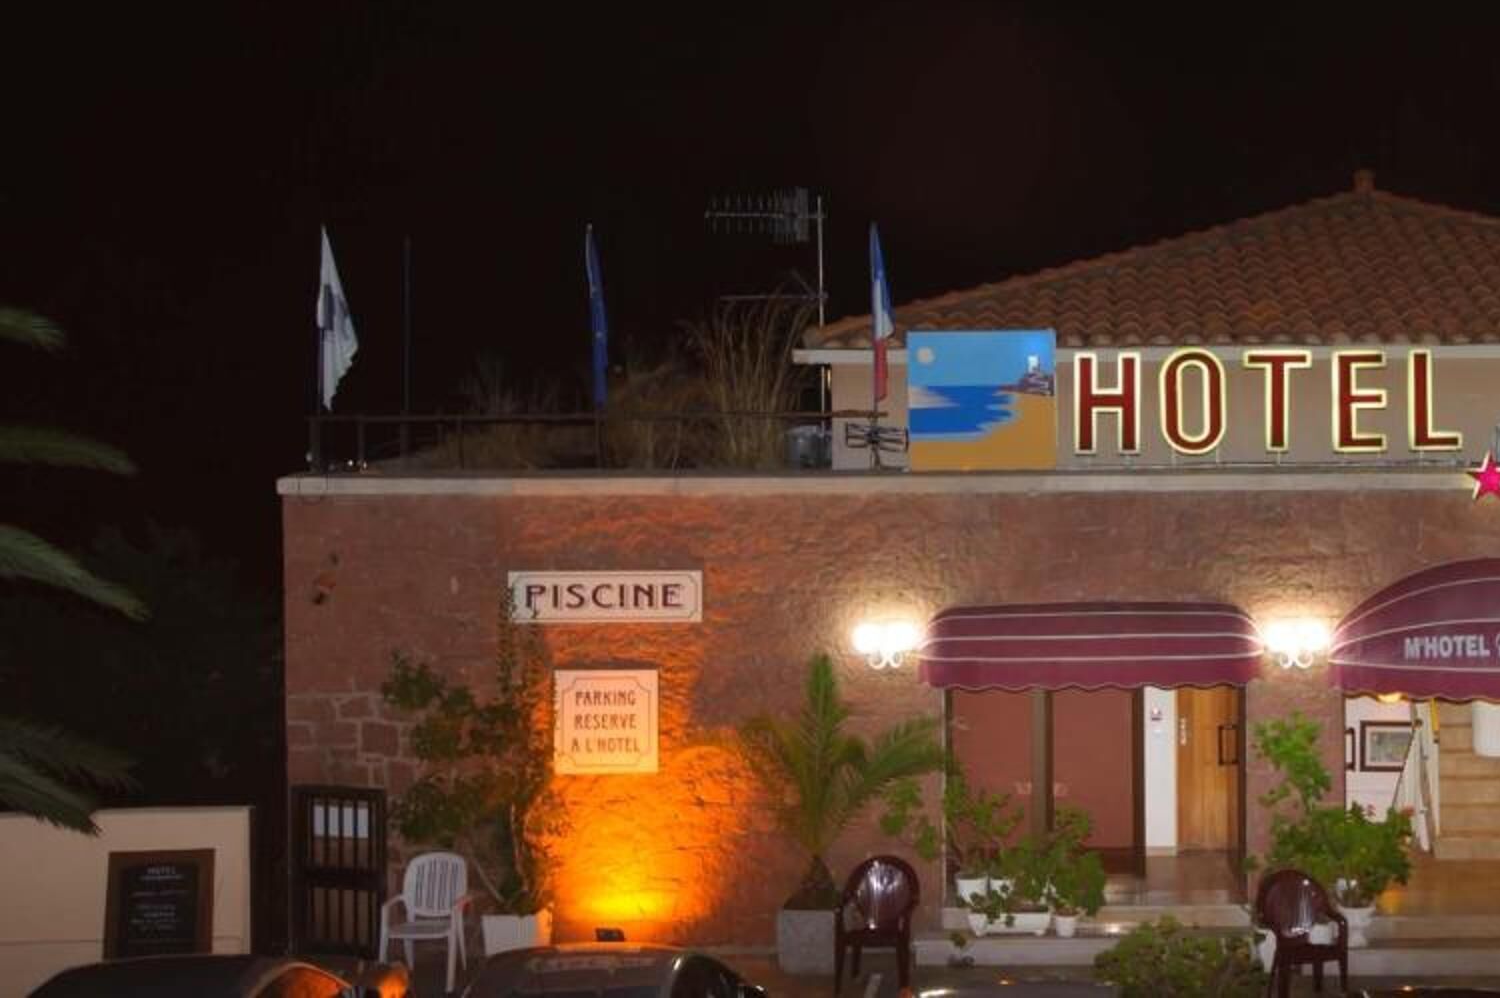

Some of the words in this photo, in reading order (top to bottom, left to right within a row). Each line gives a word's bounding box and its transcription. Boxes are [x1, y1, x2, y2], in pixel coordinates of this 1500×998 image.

[1074, 347, 1462, 455] HOTEL
[525, 583, 684, 609] PISCINE
[575, 689, 637, 707] PARKING
[573, 713, 637, 730] RESERVE
[571, 737, 581, 753] A
